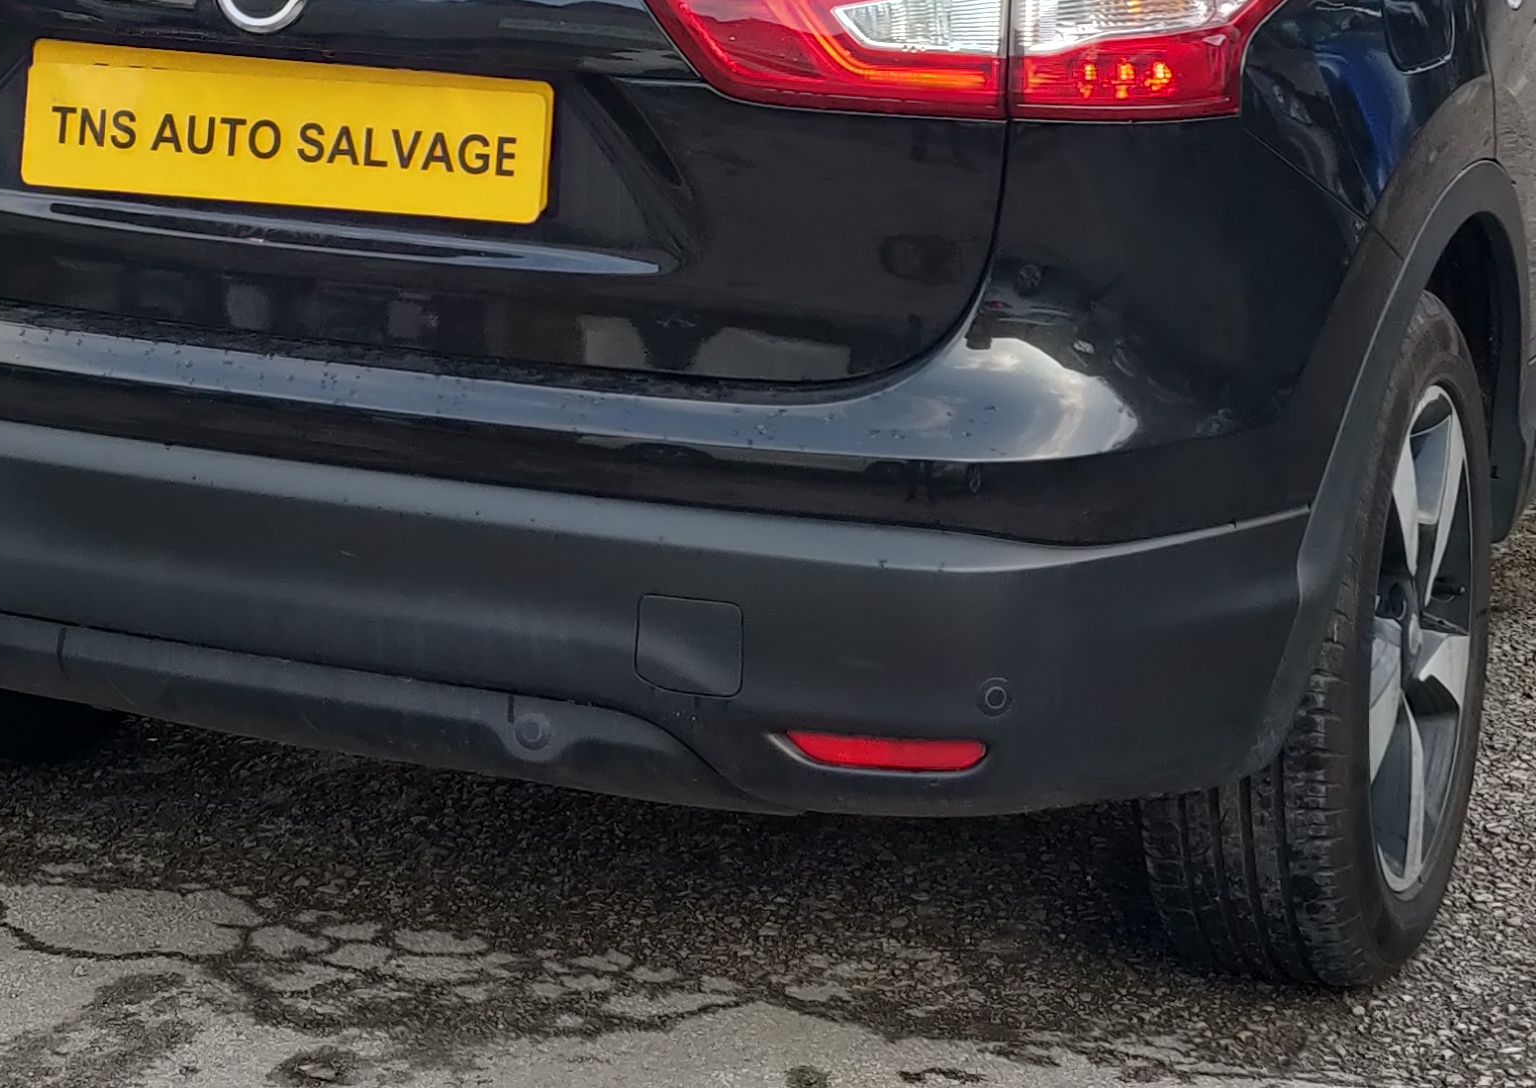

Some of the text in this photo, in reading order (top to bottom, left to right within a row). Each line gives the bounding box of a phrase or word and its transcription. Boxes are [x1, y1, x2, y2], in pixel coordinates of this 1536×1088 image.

[51, 105, 517, 177] TNS AUTO SALVAGE
